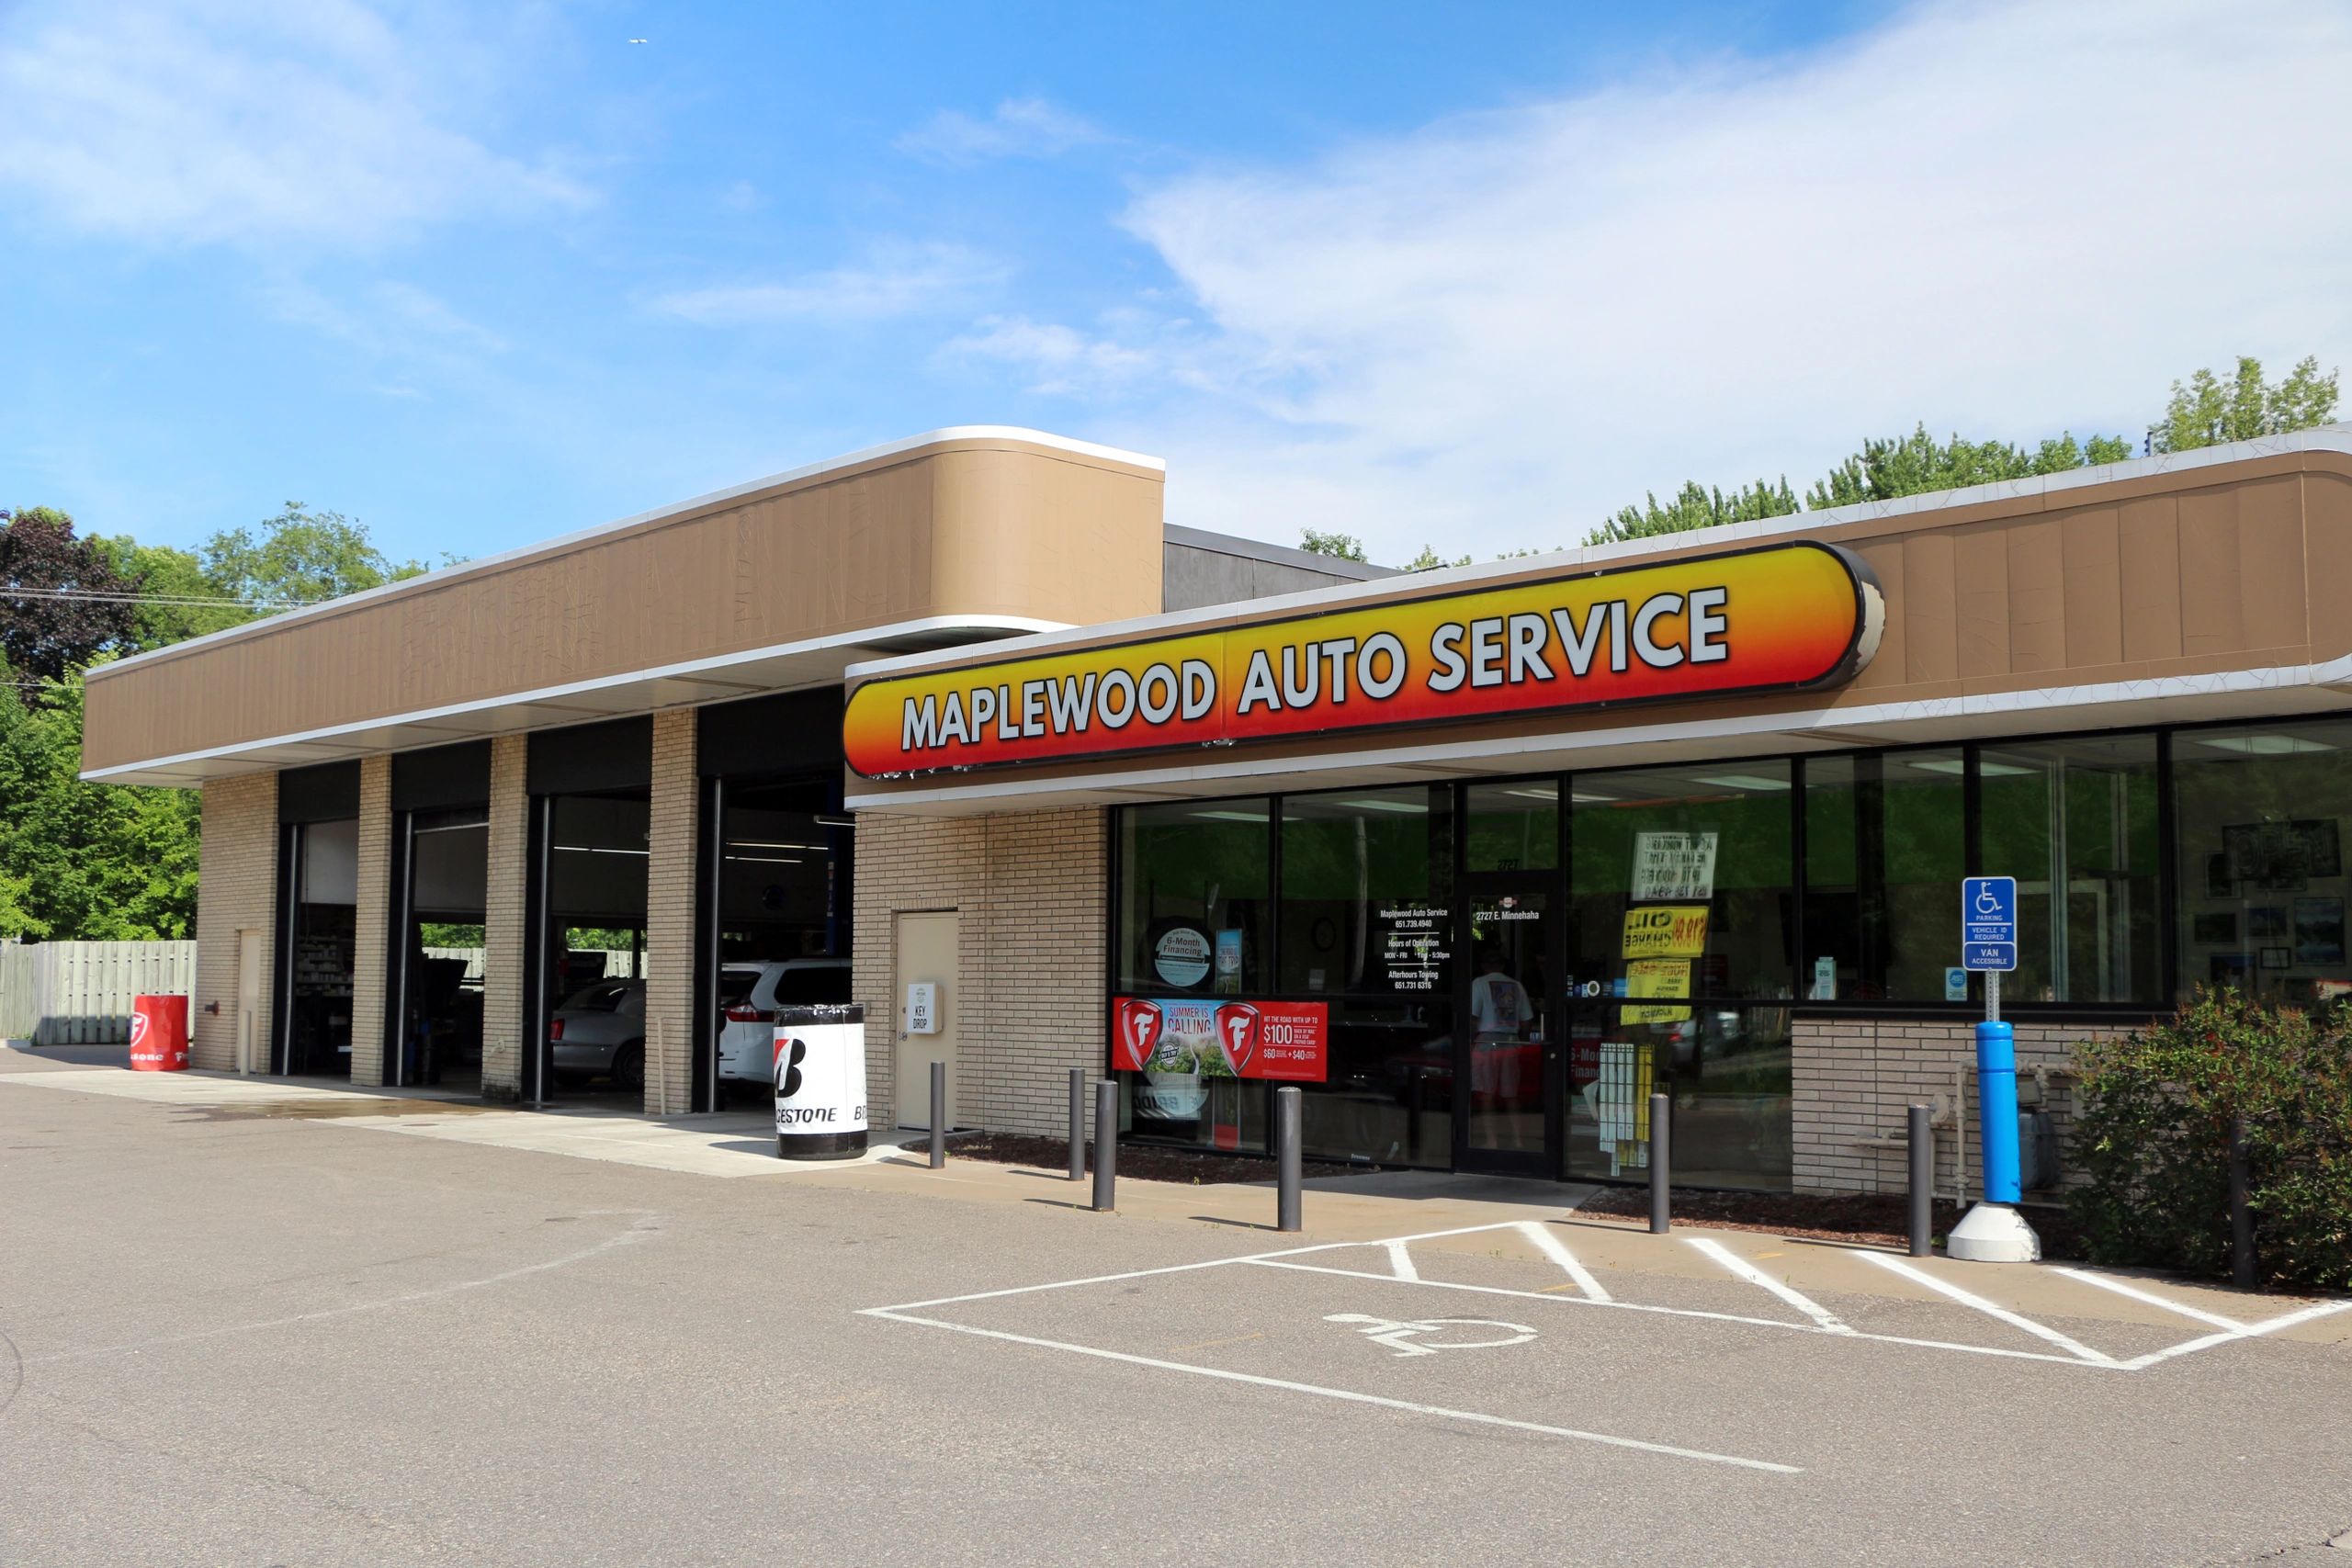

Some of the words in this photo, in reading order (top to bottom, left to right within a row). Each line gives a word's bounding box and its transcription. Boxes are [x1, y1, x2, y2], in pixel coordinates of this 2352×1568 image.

[901, 660, 1216, 750] MAPLEWOOD
[1238, 631, 1408, 714] AUTO
[1427, 586, 1727, 692] SERVICE
[1381, 909, 1411, 919] Maplewood
[1427, 908, 1448, 917] Service
[1476, 911, 1493, 920] 2727
[1502, 910, 1540, 919] Minnehaha
[1167, 937, 1201, 946] 6-Month
[1412, 939, 1440, 948] Operation
[1163, 945, 1203, 956] Financing
[1980, 949, 1999, 957] VAN
[1419, 971, 1439, 979] Towing
[915, 1006, 926, 1016] KEY
[1169, 1007, 1200, 1018] SUMMER
[1202, 1008, 1209, 1018] IS
[913, 1019, 927, 1029] DROP
[1168, 1018, 1211, 1034] CALLING
[1264, 1024, 1293, 1044] $100
[1264, 1048, 1275, 1058] $60
[1293, 1050, 1305, 1060] $40
